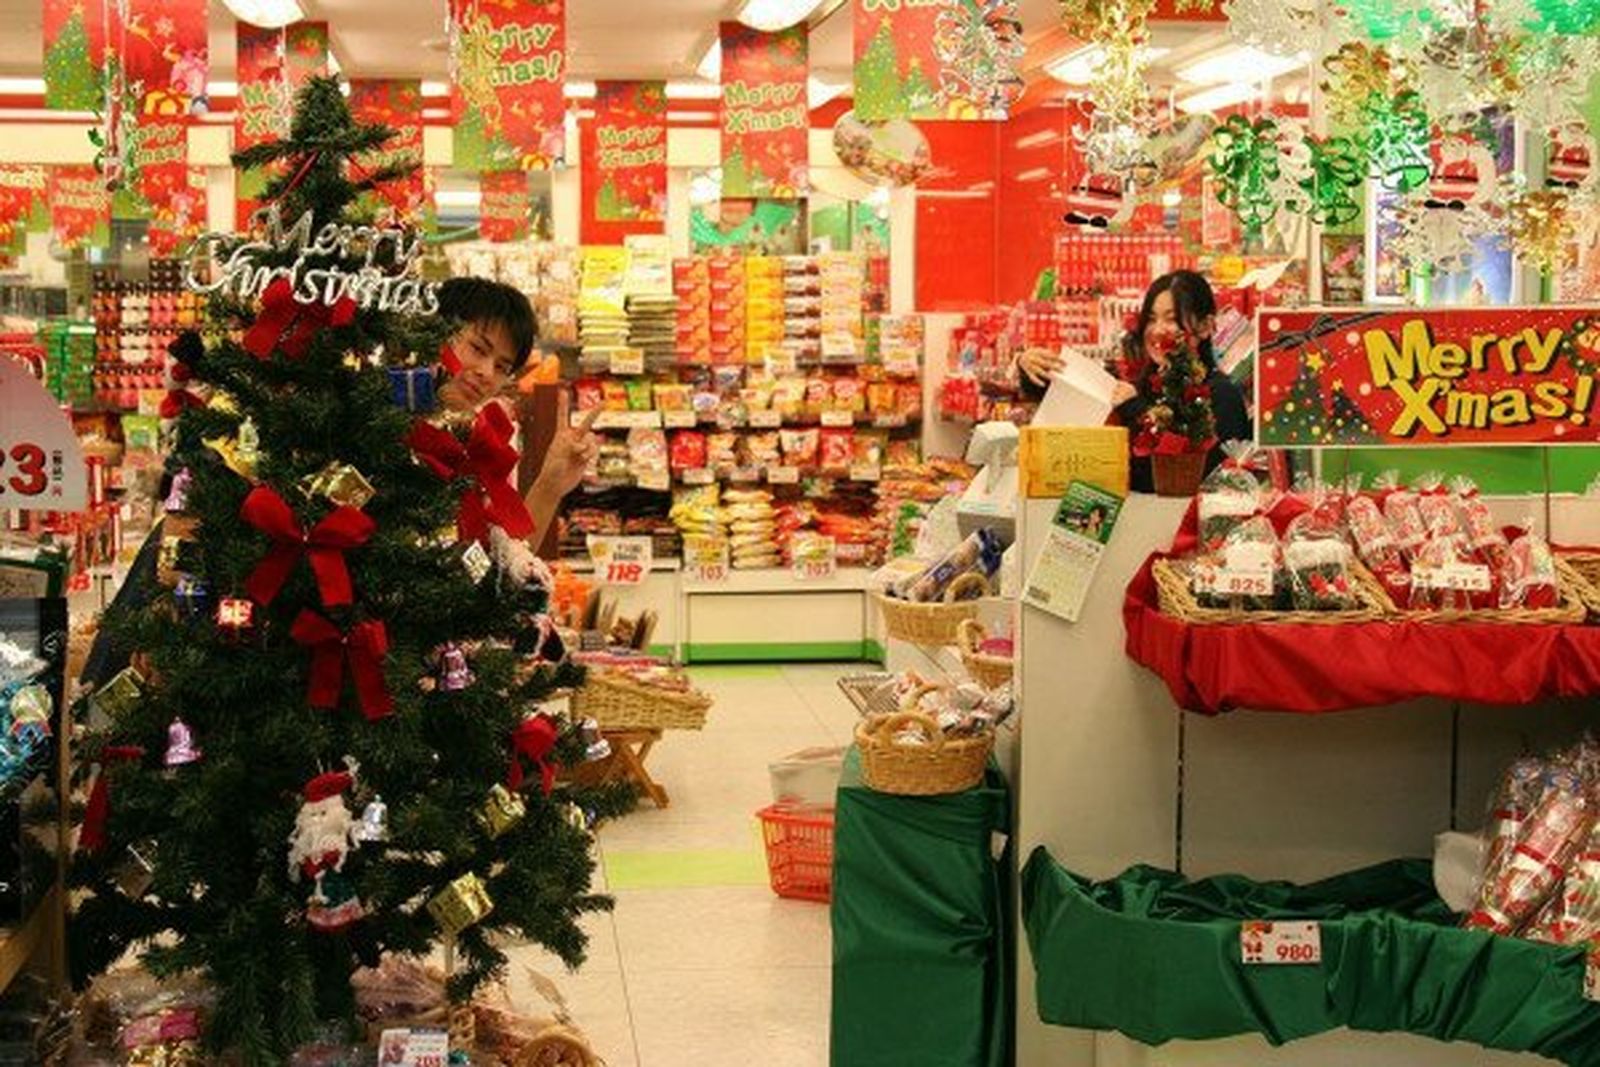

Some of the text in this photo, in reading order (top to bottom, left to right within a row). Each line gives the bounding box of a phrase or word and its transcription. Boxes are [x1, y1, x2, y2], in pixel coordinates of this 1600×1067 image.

[724, 80, 802, 108] Merry
[724, 103, 806, 134] X'mas!
[597, 125, 664, 147] Merry
[252, 203, 425, 281] Merry
[1364, 319, 1564, 388] Merry
[1390, 374, 1594, 436] X'mas!
[1276, 943, 1314, 961] 980
